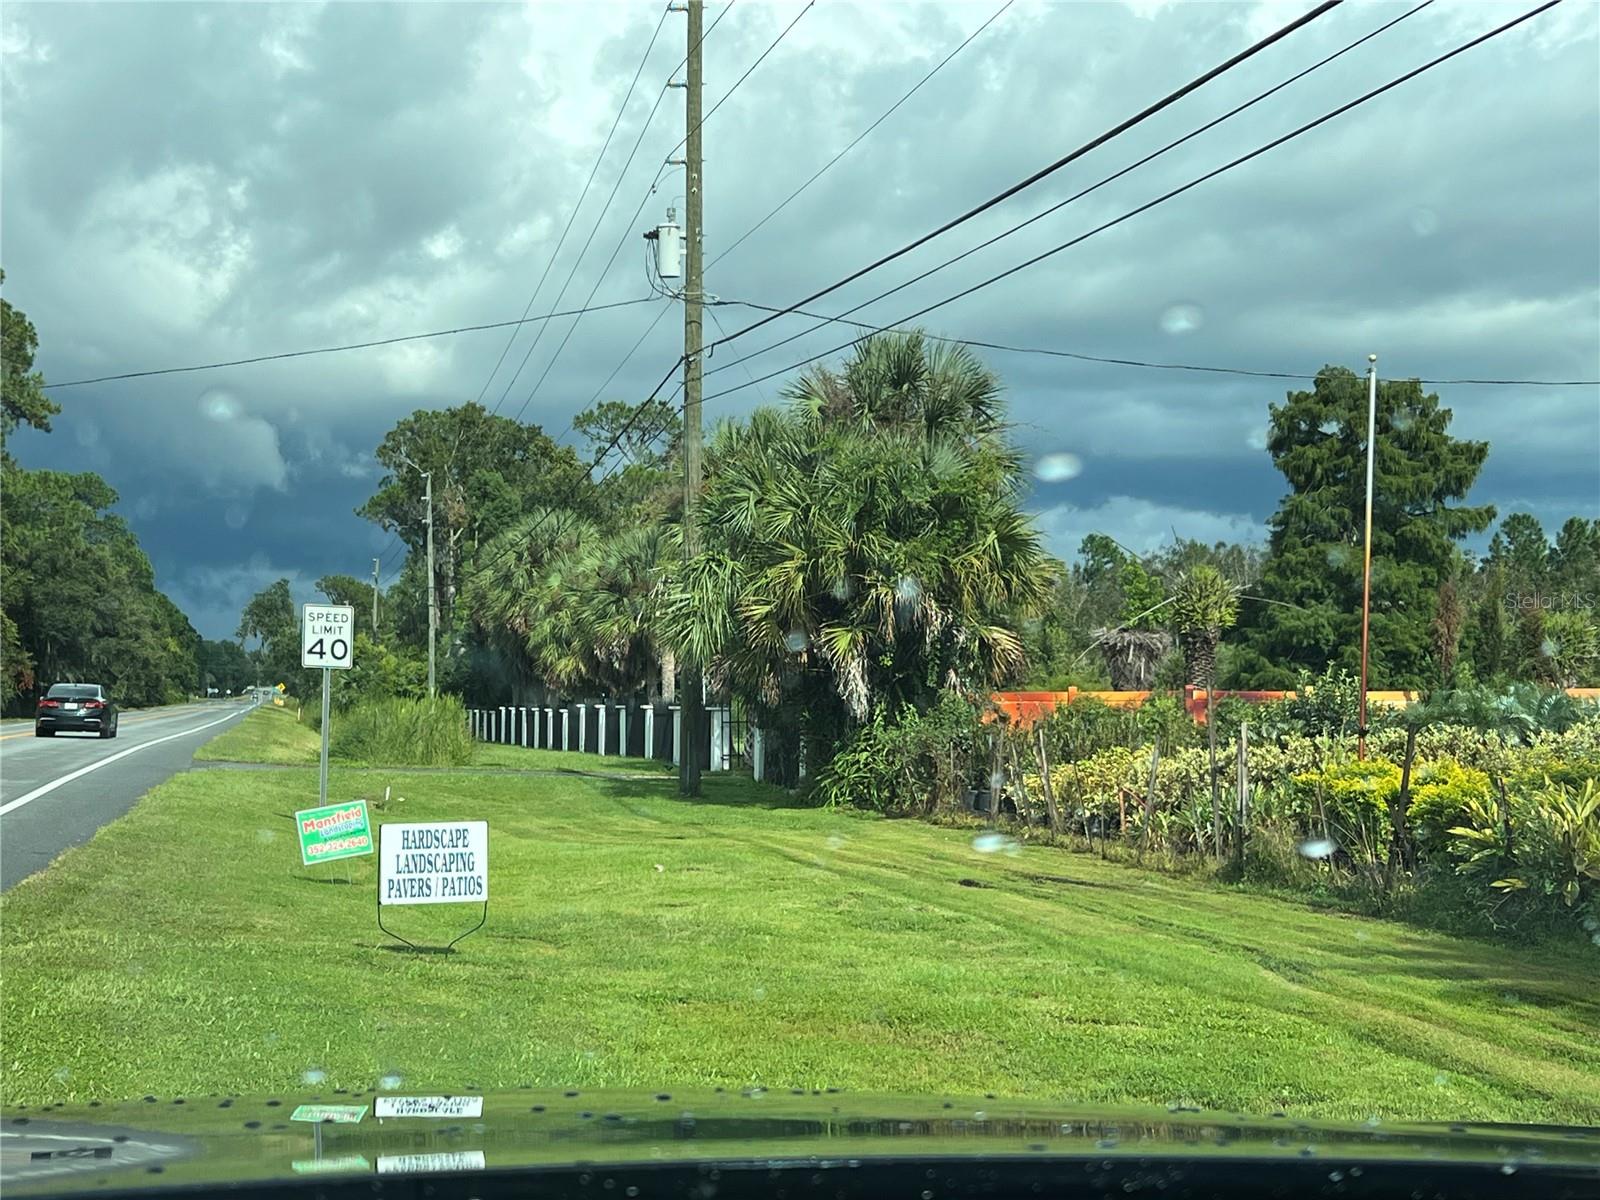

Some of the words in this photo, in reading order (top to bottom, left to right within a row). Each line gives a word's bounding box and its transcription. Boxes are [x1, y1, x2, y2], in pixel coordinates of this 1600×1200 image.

[308, 612, 349, 623] SPEED
[313, 625, 343, 635] LIMIT
[307, 638, 348, 660] 40
[303, 808, 362, 833] Mansfield
[401, 828, 470, 850] HARDSCAPE
[396, 852, 475, 874] LANDSCAPING
[387, 878, 432, 899] PAVERS
[441, 876, 483, 897] PATIOS
